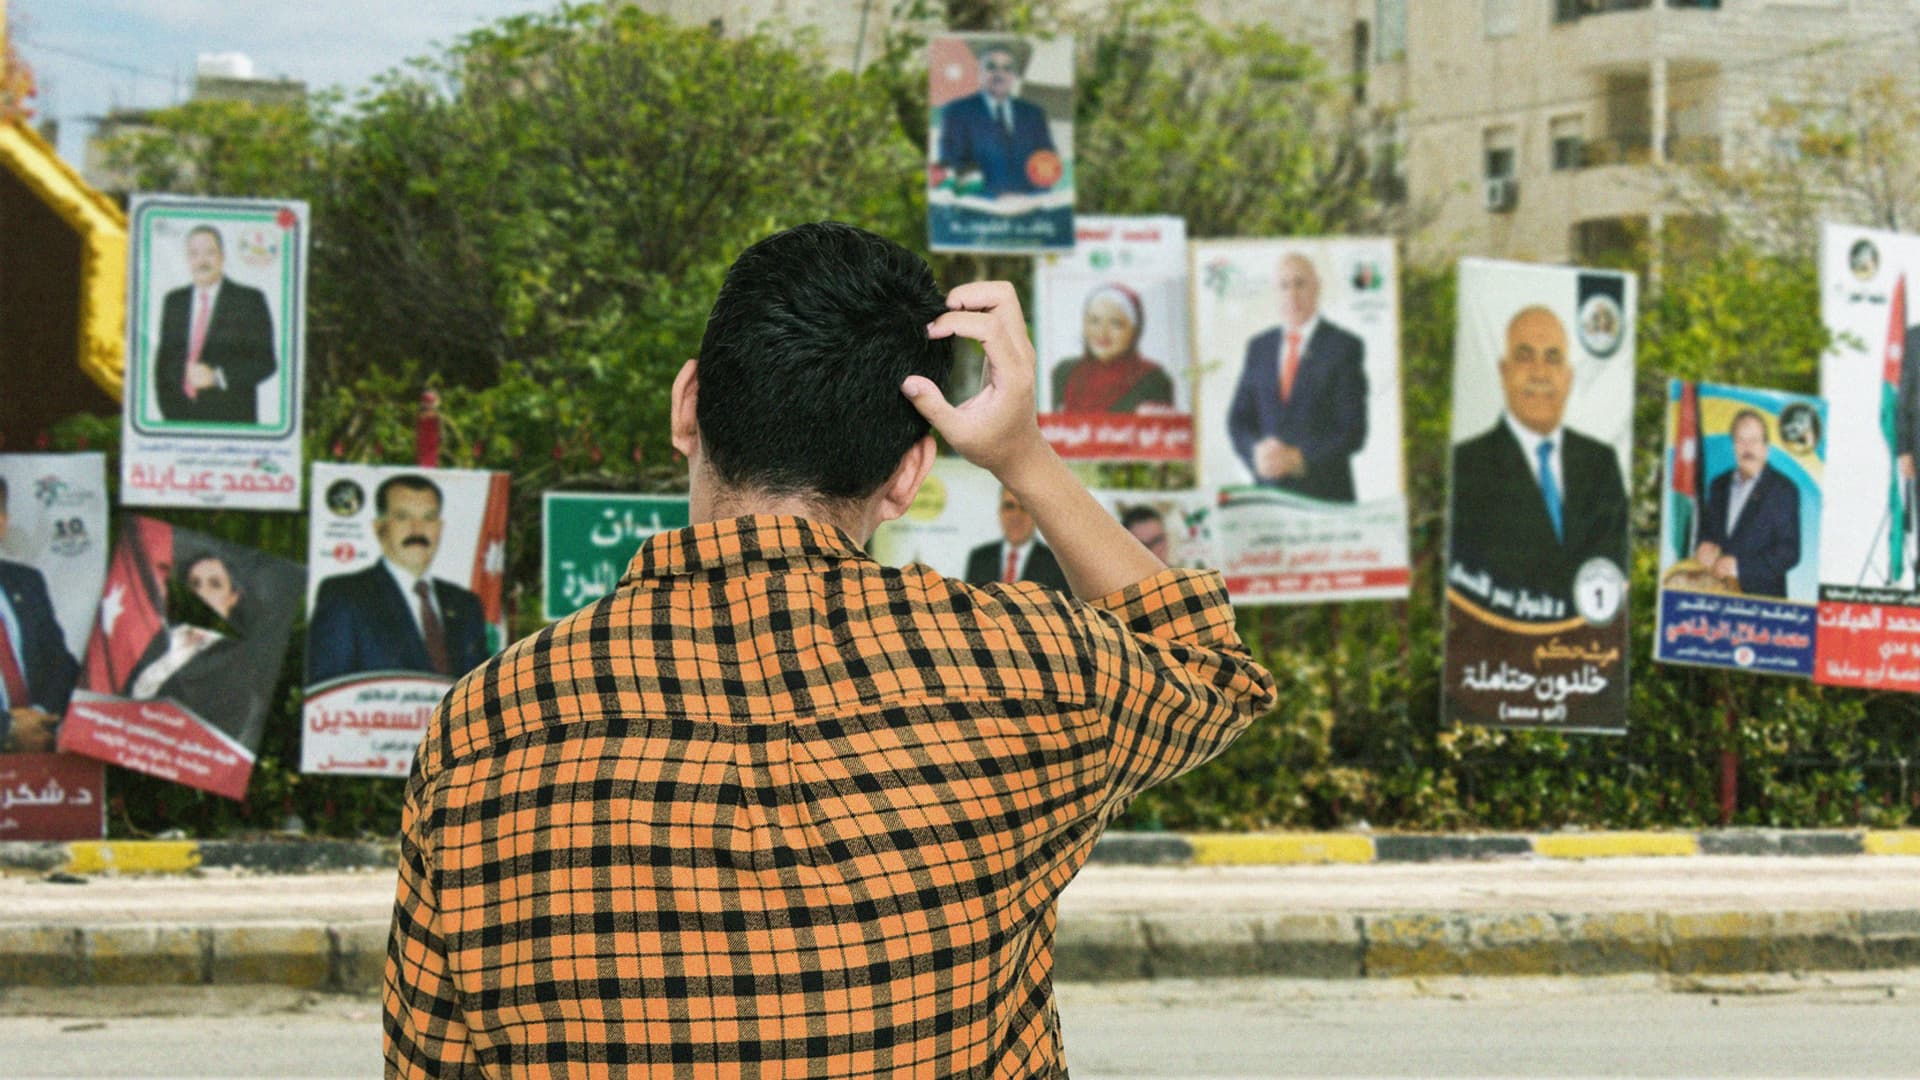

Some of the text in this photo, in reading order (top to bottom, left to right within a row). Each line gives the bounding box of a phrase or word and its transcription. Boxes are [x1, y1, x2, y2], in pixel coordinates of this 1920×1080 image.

[221, 471, 296, 493] محمد
[1535, 664, 1609, 701] خلدون
[309, 704, 433, 736] السعيدين
[0, 777, 66, 810] شكر
